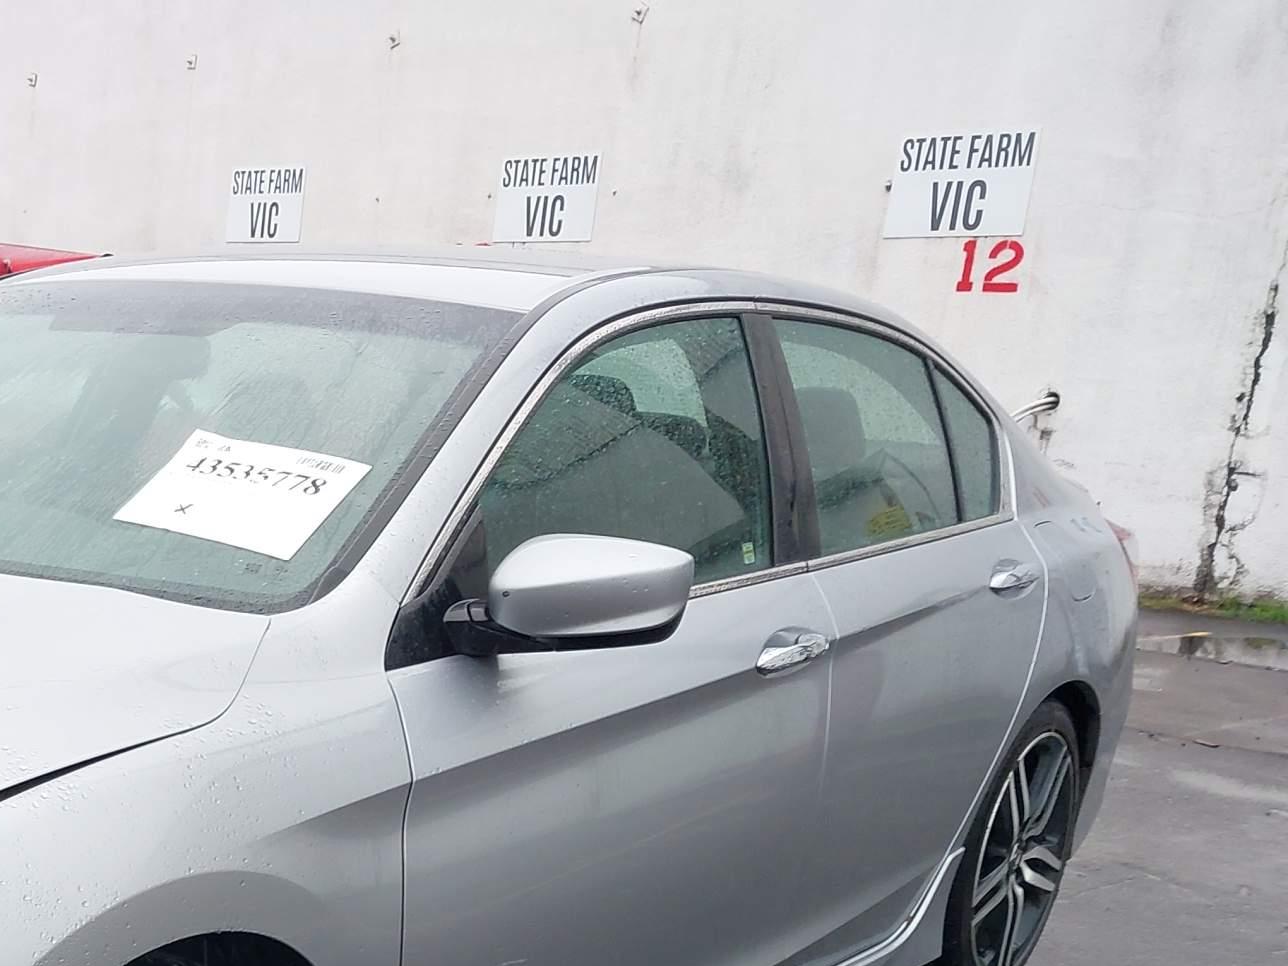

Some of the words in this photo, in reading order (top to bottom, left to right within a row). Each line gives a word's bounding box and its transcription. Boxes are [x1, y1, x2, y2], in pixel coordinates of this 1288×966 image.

[502, 159, 547, 188] STATE
[550, 155, 598, 185] FARM
[900, 136, 963, 172] STATE
[966, 132, 1036, 168] FARM
[232, 169, 265, 194] STATE
[267, 168, 303, 193] FARM
[249, 202, 279, 238] VIC
[525, 195, 565, 237] VIC
[930, 180, 987, 231] VIC
[956, 240, 1024, 292] 12
[186, 456, 327, 496] 43535778
